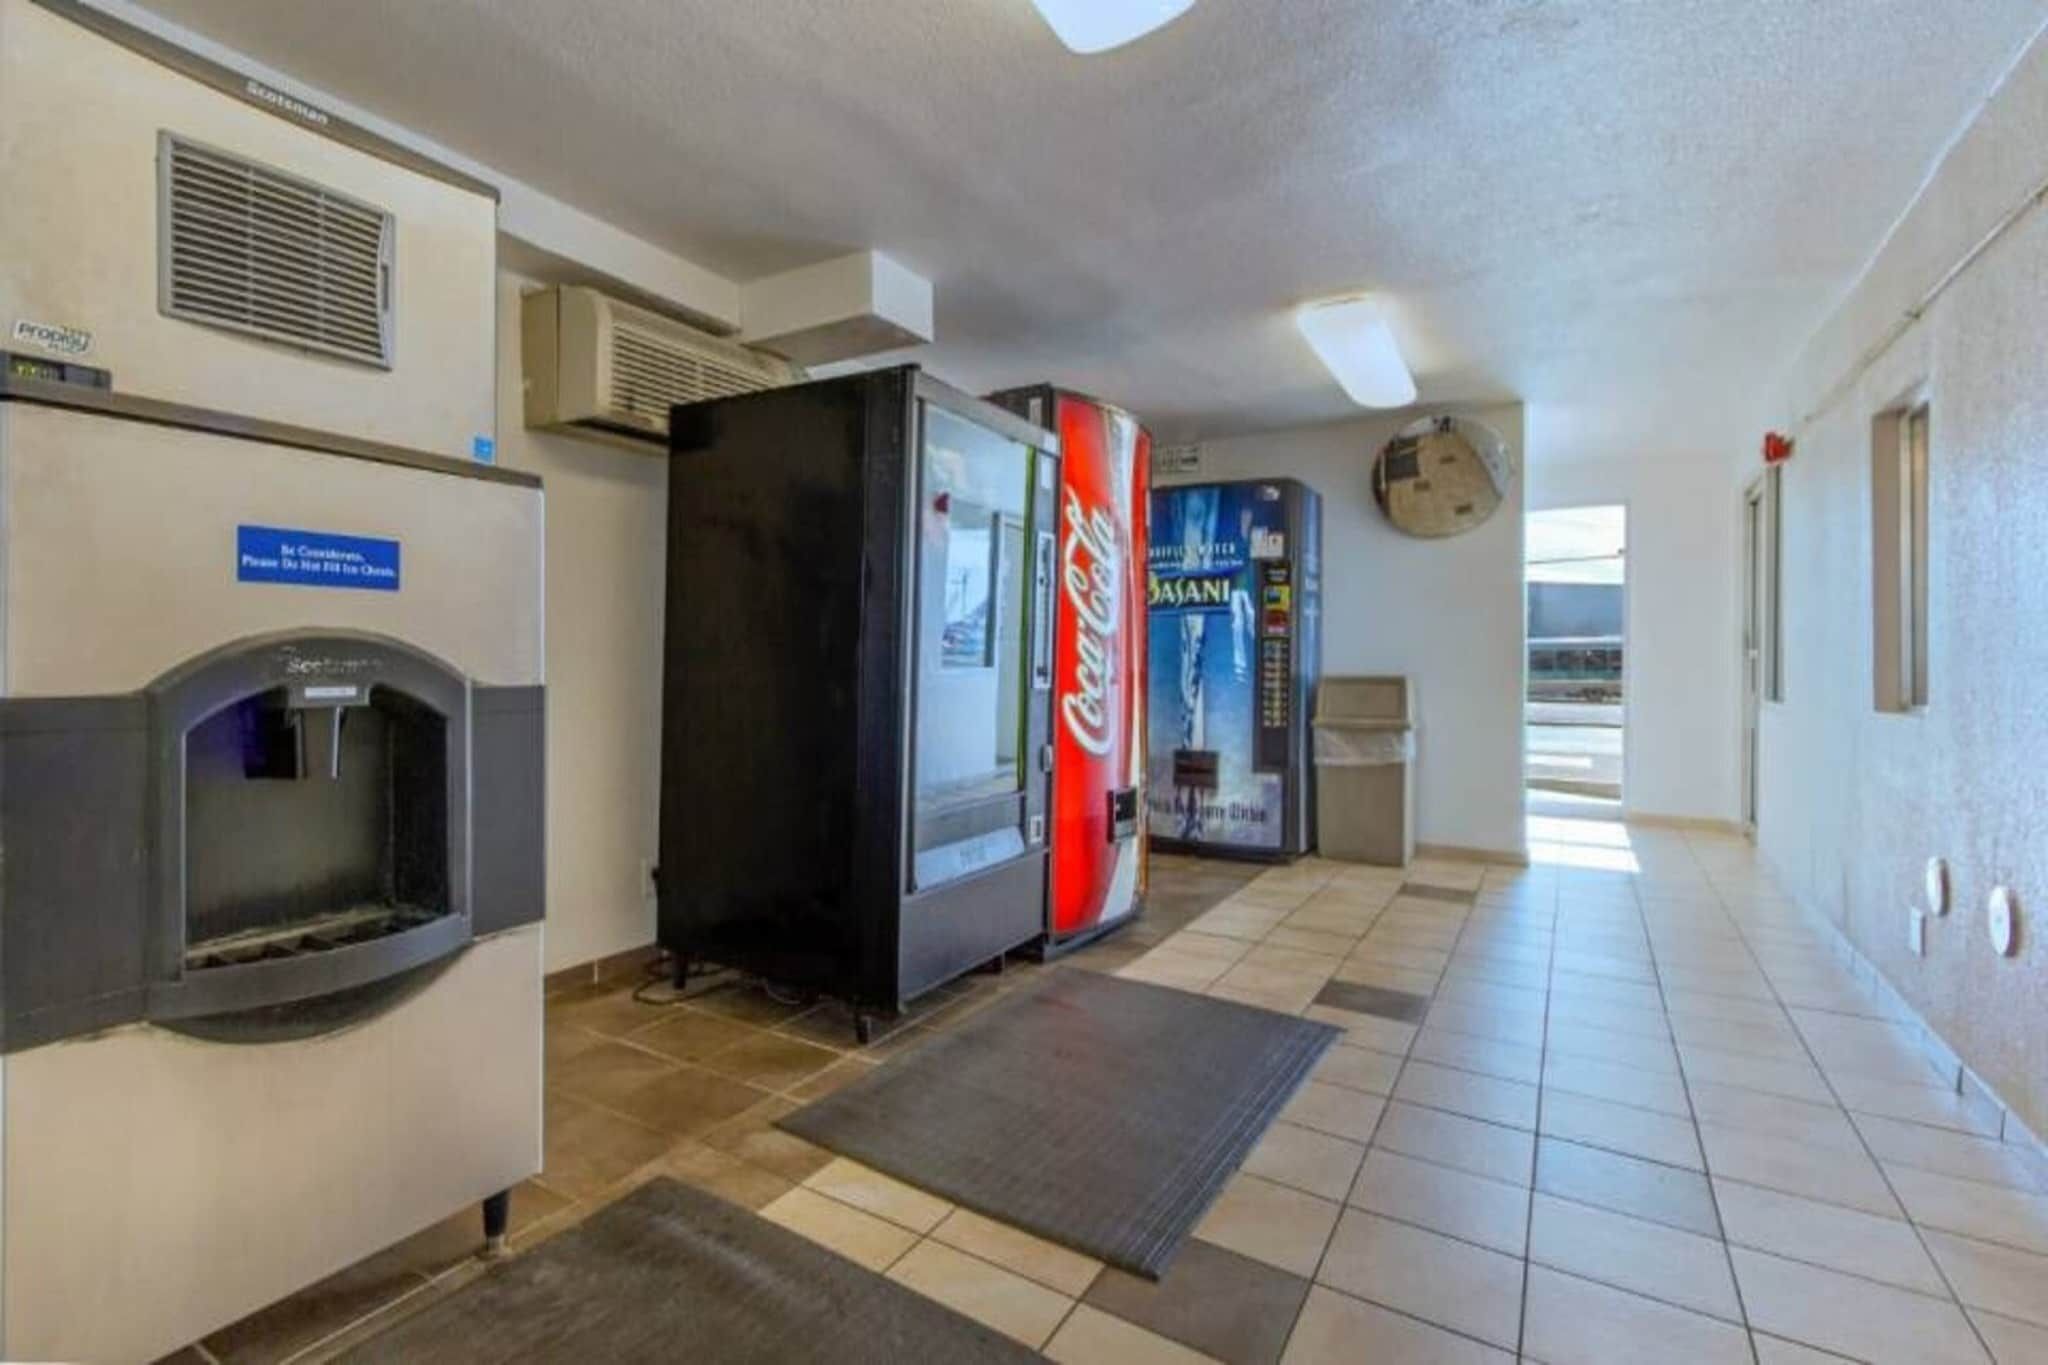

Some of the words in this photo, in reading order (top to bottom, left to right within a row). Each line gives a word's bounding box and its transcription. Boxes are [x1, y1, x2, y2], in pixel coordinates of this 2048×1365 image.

[247, 80, 328, 125] Scotsman
[242, 555, 279, 568] Please
[282, 558, 298, 569] Do
[301, 559, 321, 571] Not
[281, 544, 296, 556] Be
[1063, 483, 1119, 756] Coca-Cola
